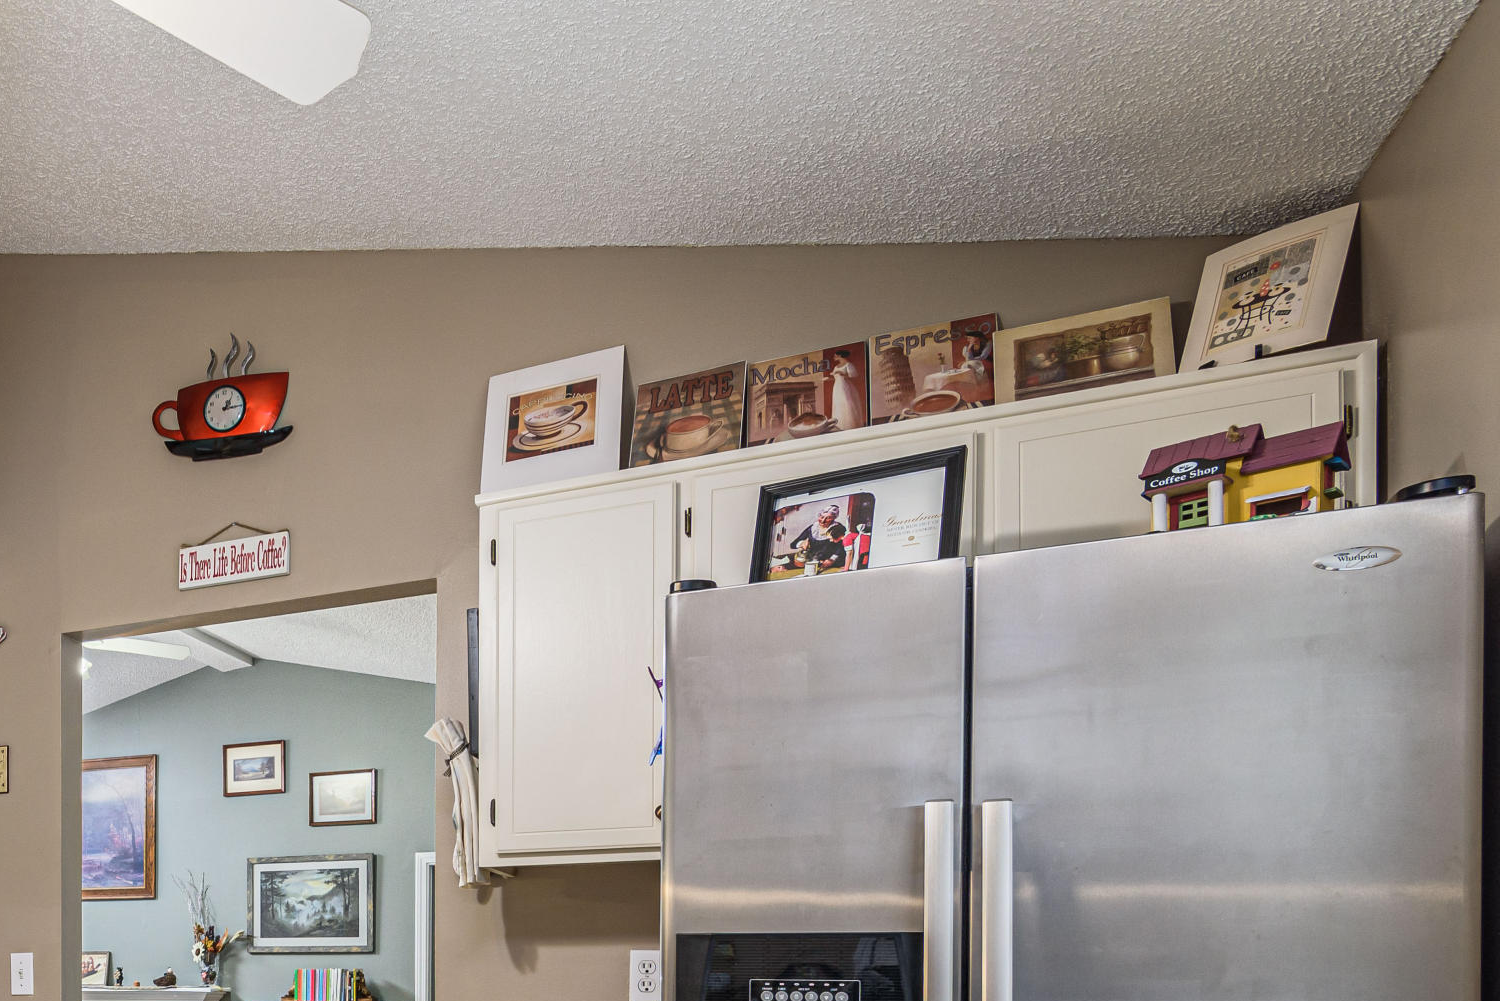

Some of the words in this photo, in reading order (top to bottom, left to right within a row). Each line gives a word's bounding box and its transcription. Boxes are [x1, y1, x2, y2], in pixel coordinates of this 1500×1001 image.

[875, 320, 993, 356] Espresso
[751, 356, 831, 386] Mocha
[649, 371, 734, 414] LATTE
[1150, 474, 1187, 488] Coffee
[1190, 465, 1219, 479] Shop
[180, 554, 187, 583] Is
[189, 551, 211, 581] There
[213, 546, 228, 578] Life
[230, 543, 255, 575] Before
[257, 535, 287, 571] Coffee?
[1337, 552, 1378, 562] Whirlpool
